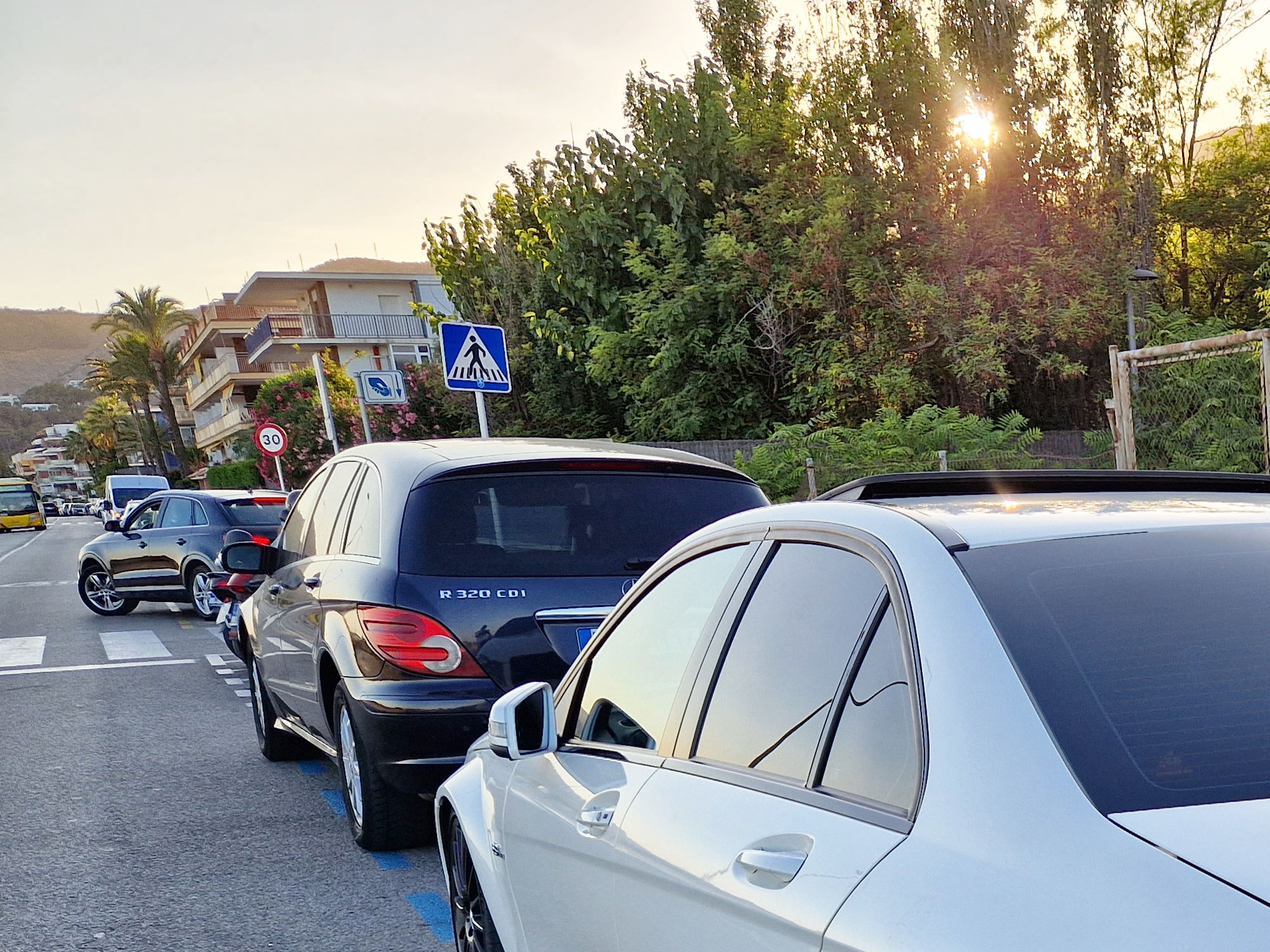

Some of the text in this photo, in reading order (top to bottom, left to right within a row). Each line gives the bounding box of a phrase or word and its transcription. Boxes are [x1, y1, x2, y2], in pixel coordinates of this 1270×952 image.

[262, 434, 281, 446] 30
[439, 589, 527, 599] R 320 CDI
